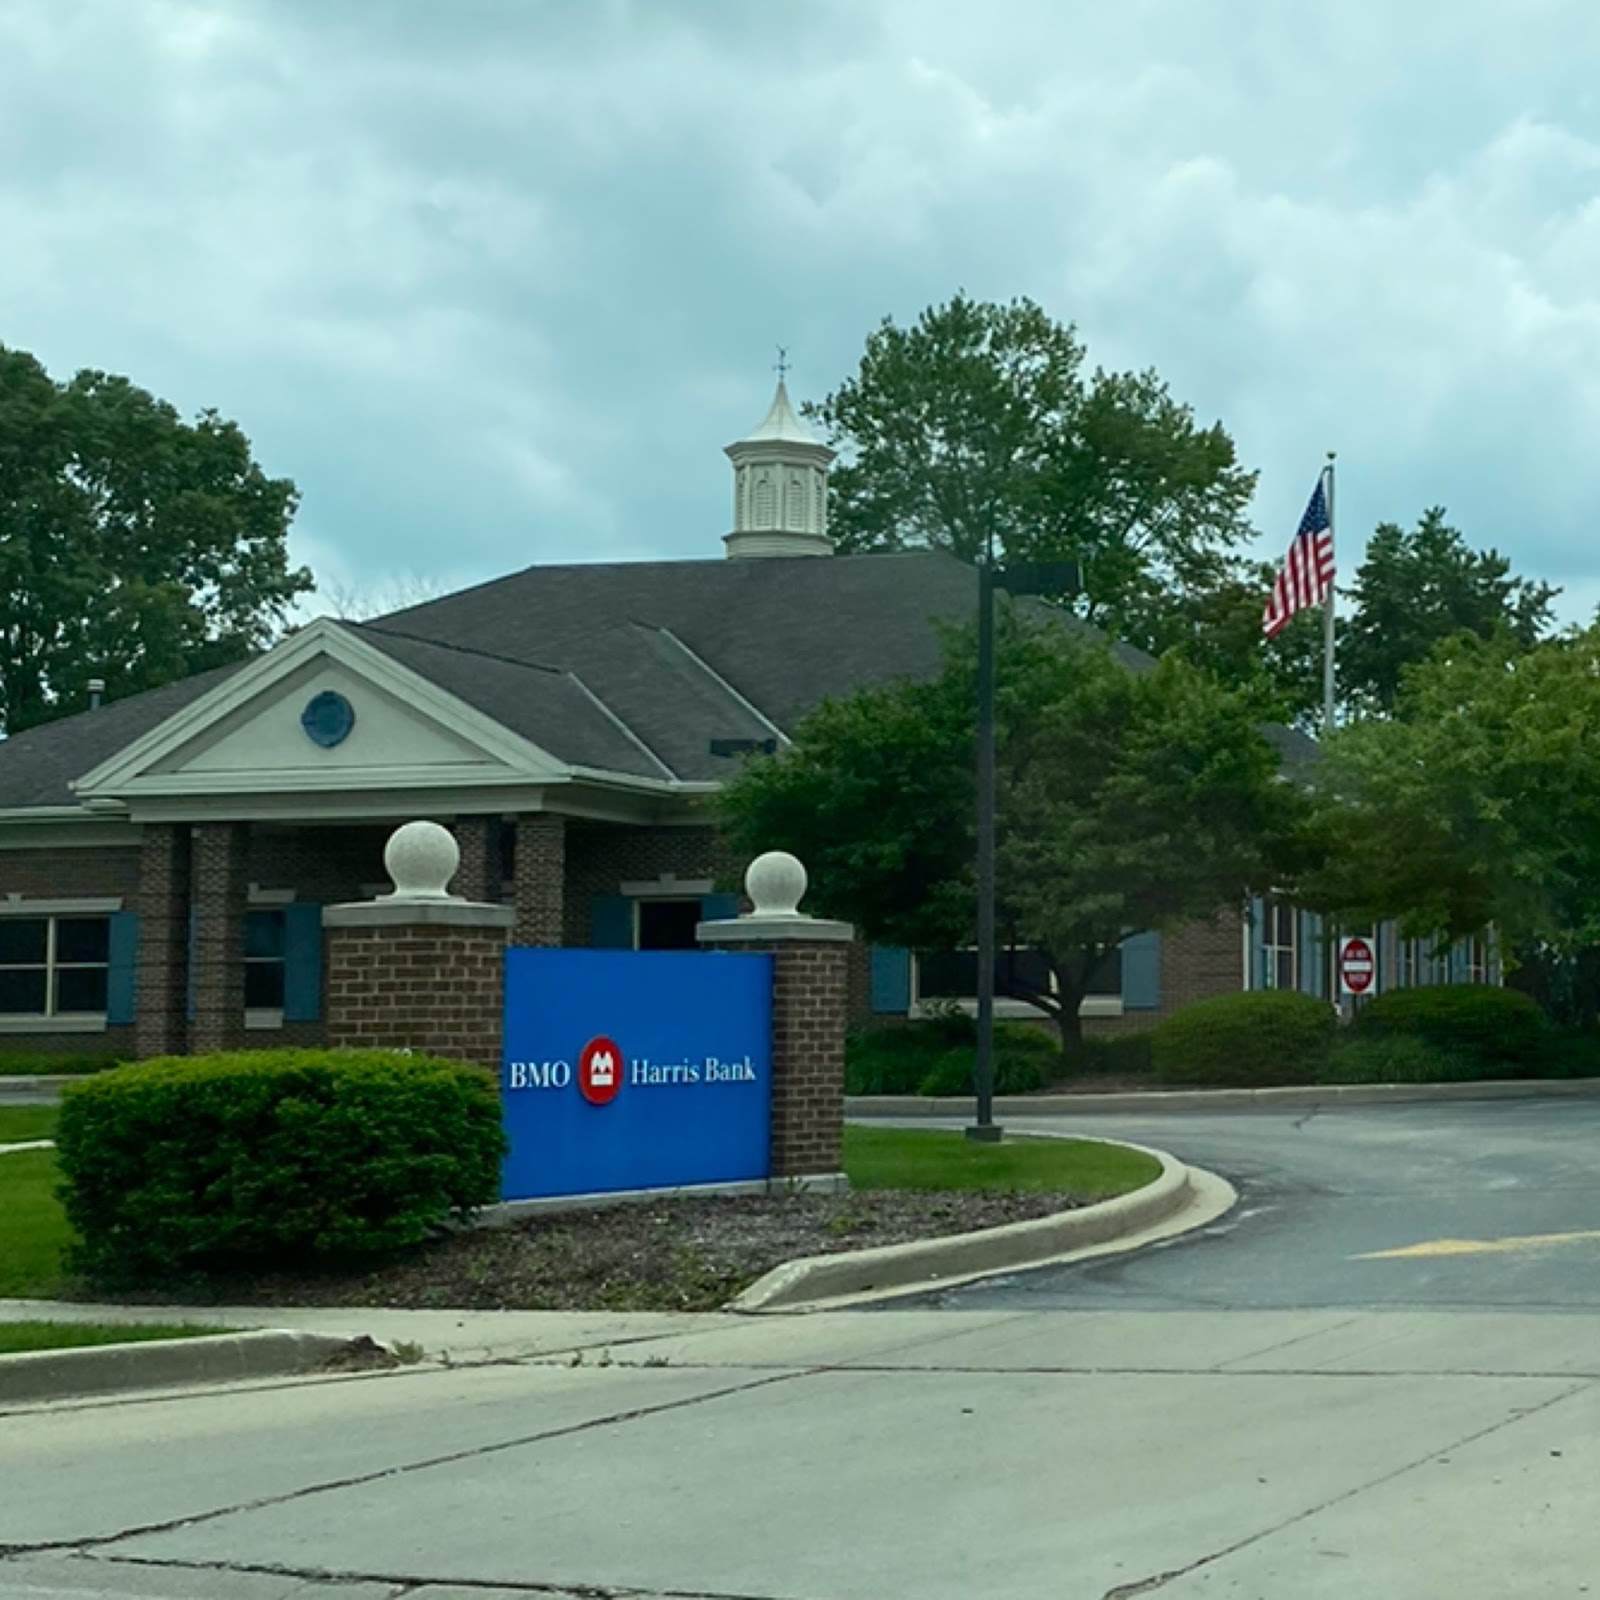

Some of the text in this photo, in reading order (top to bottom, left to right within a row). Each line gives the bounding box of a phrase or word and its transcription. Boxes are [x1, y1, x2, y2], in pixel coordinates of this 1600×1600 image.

[509, 1055, 756, 1088] BMO Harris Bank
